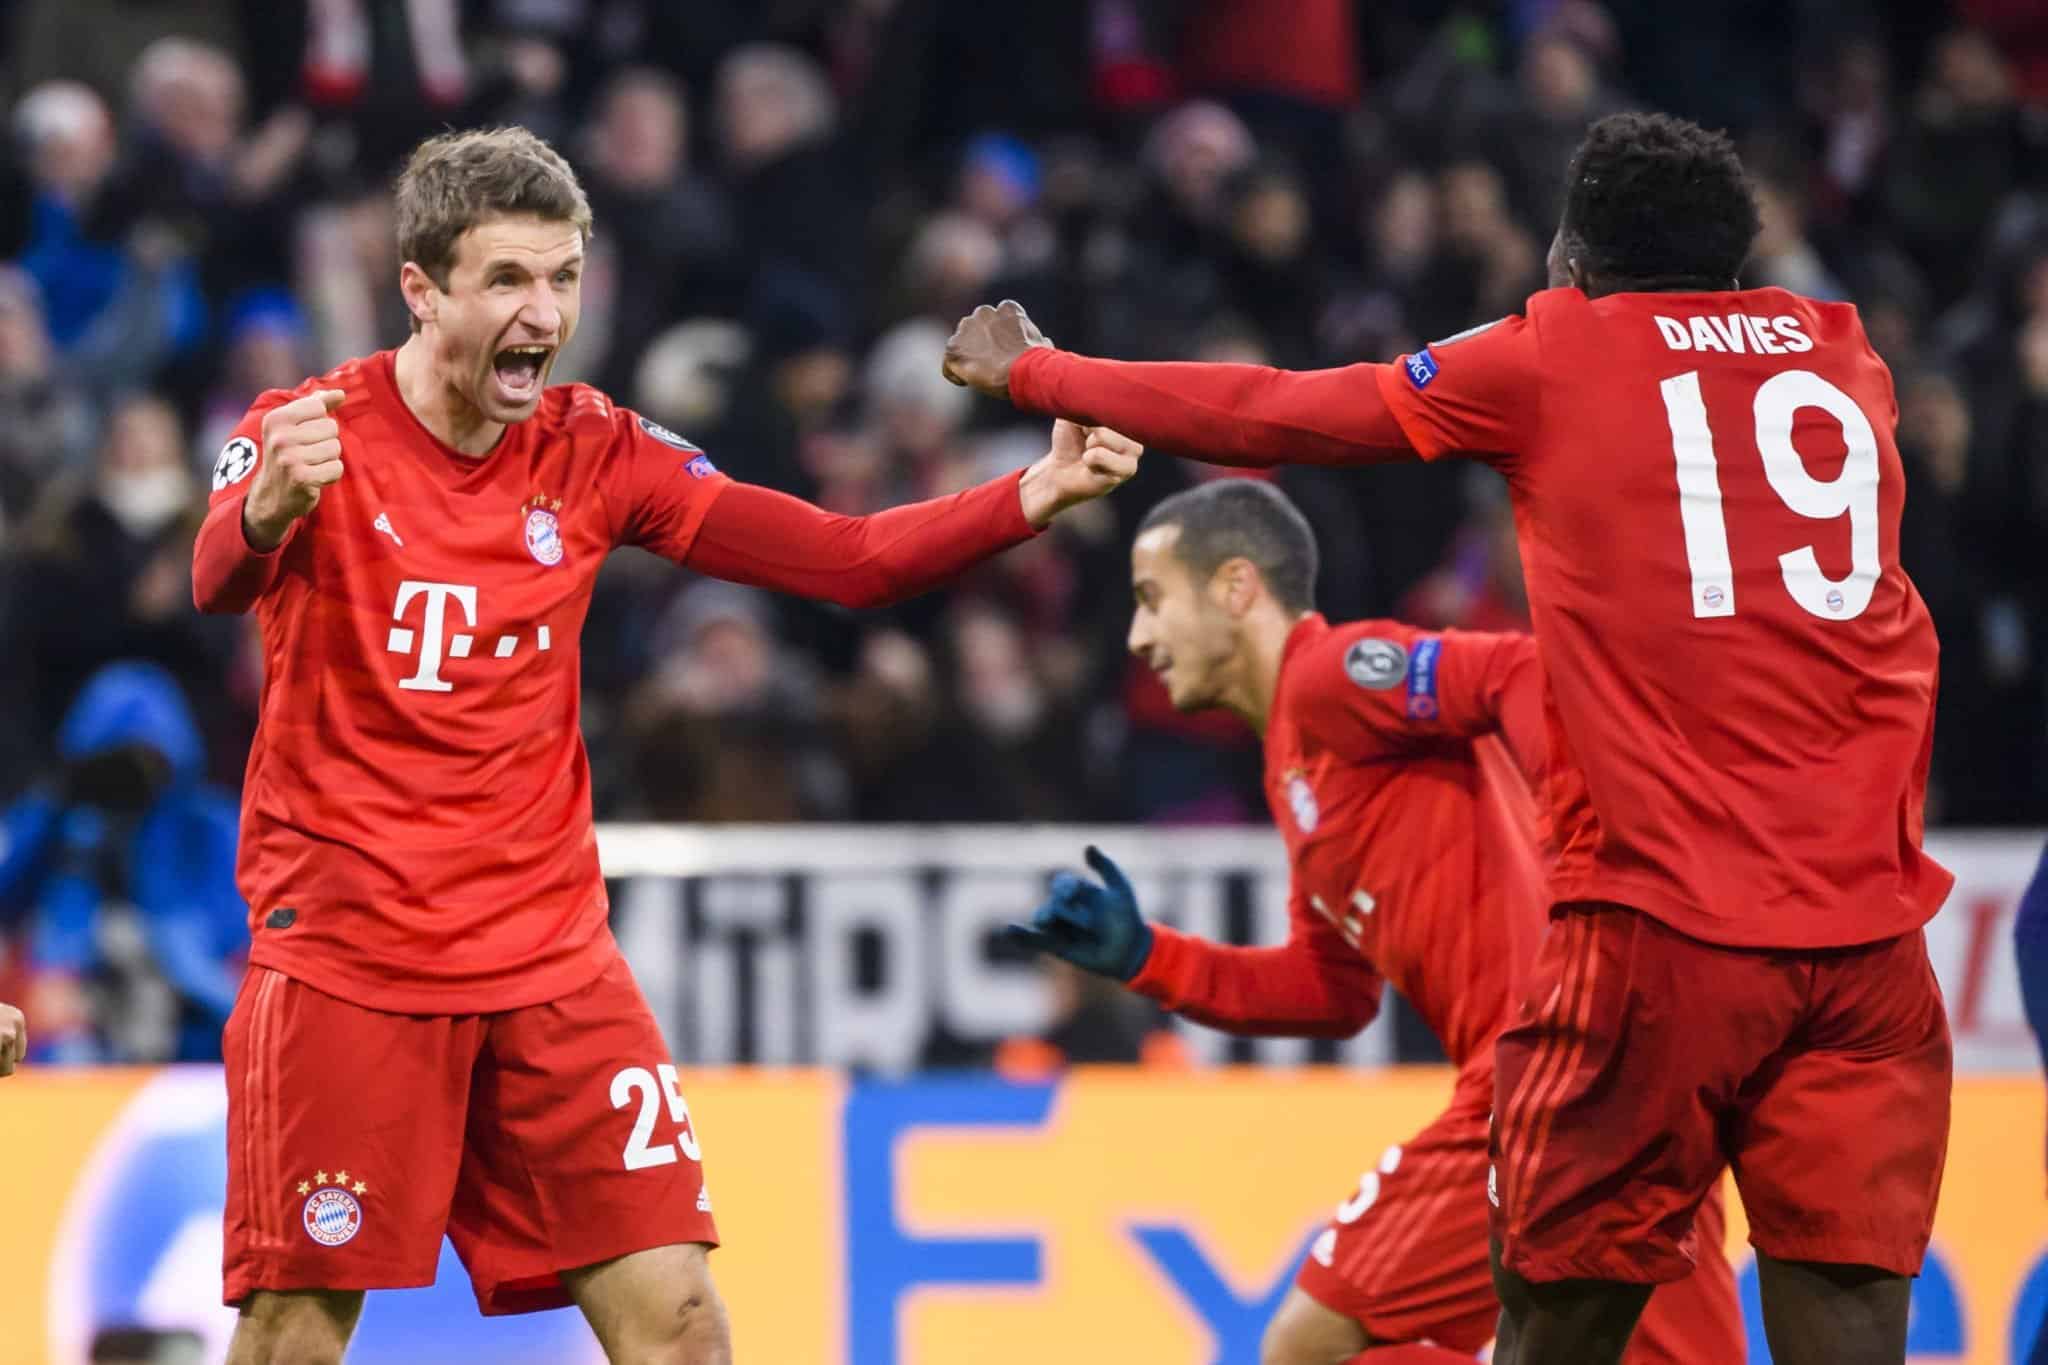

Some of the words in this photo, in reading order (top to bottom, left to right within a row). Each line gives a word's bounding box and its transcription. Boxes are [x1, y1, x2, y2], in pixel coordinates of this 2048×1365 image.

[1654, 314, 1814, 354] DAVIES
[1659, 369, 1882, 621] 19
[610, 1063, 702, 1171] 25
[318, 1191, 356, 1213] BAYERN
